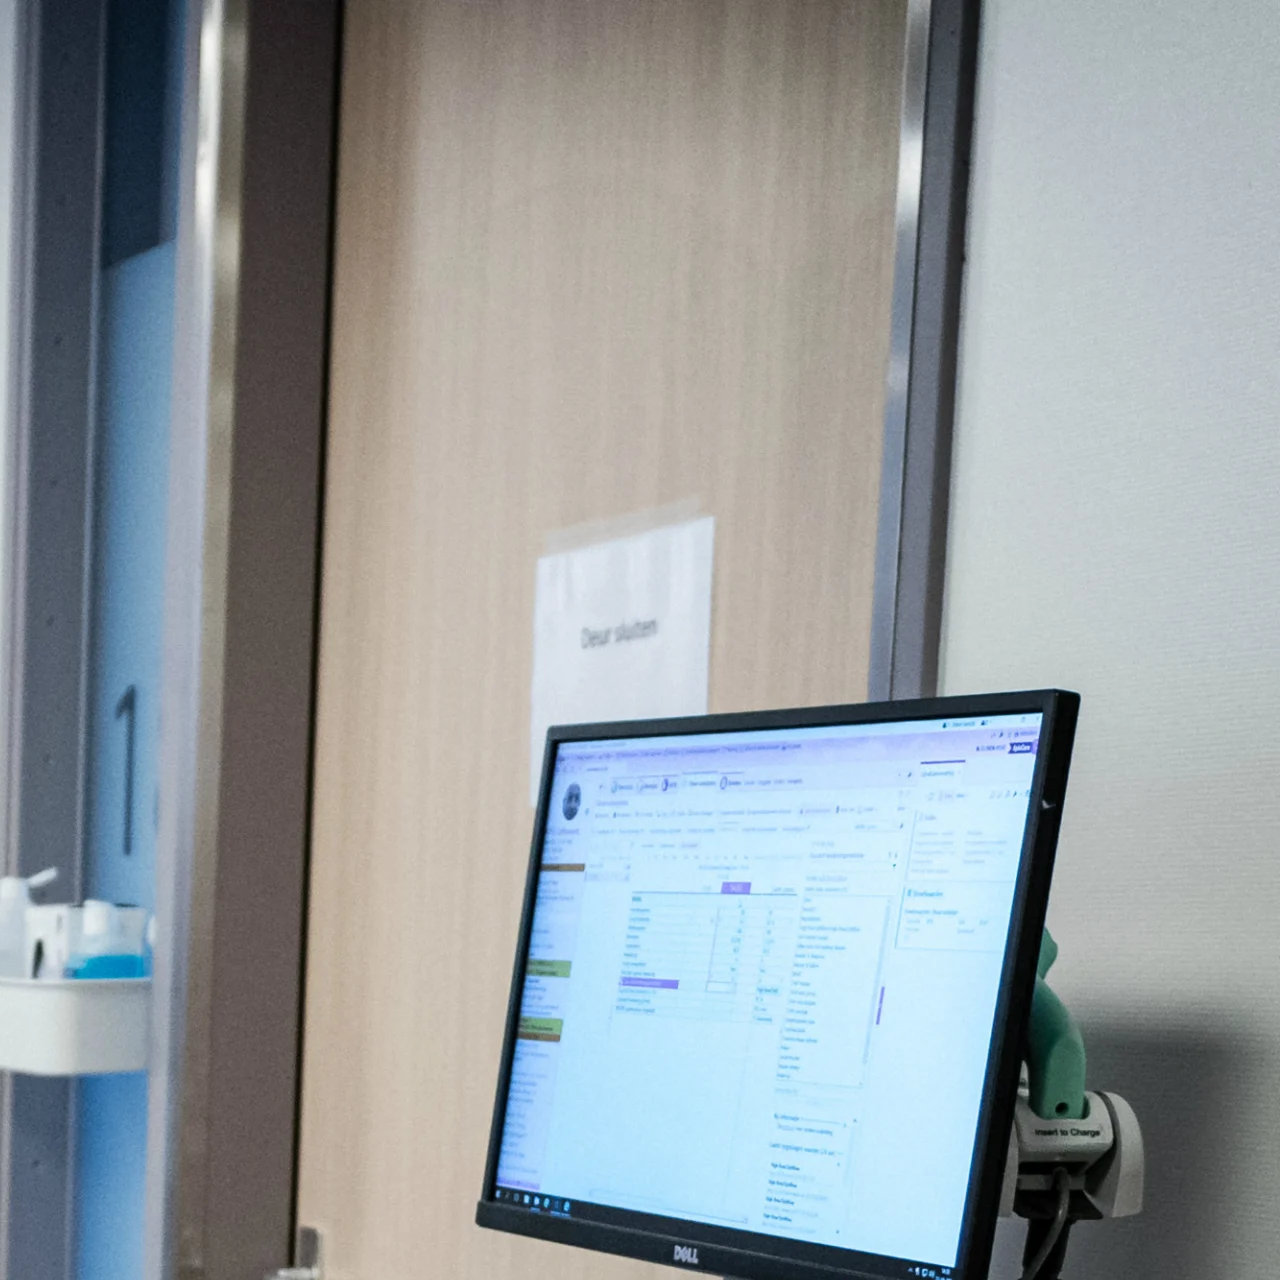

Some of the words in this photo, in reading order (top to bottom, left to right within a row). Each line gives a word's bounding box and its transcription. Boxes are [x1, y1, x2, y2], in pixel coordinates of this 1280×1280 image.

[580, 627, 611, 649] Deur
[1035, 1128, 1058, 1136] Insert
[1060, 1128, 1068, 1136] to
[1070, 1128, 1100, 1138] Charge
[673, 1245, 699, 1264] DELL
